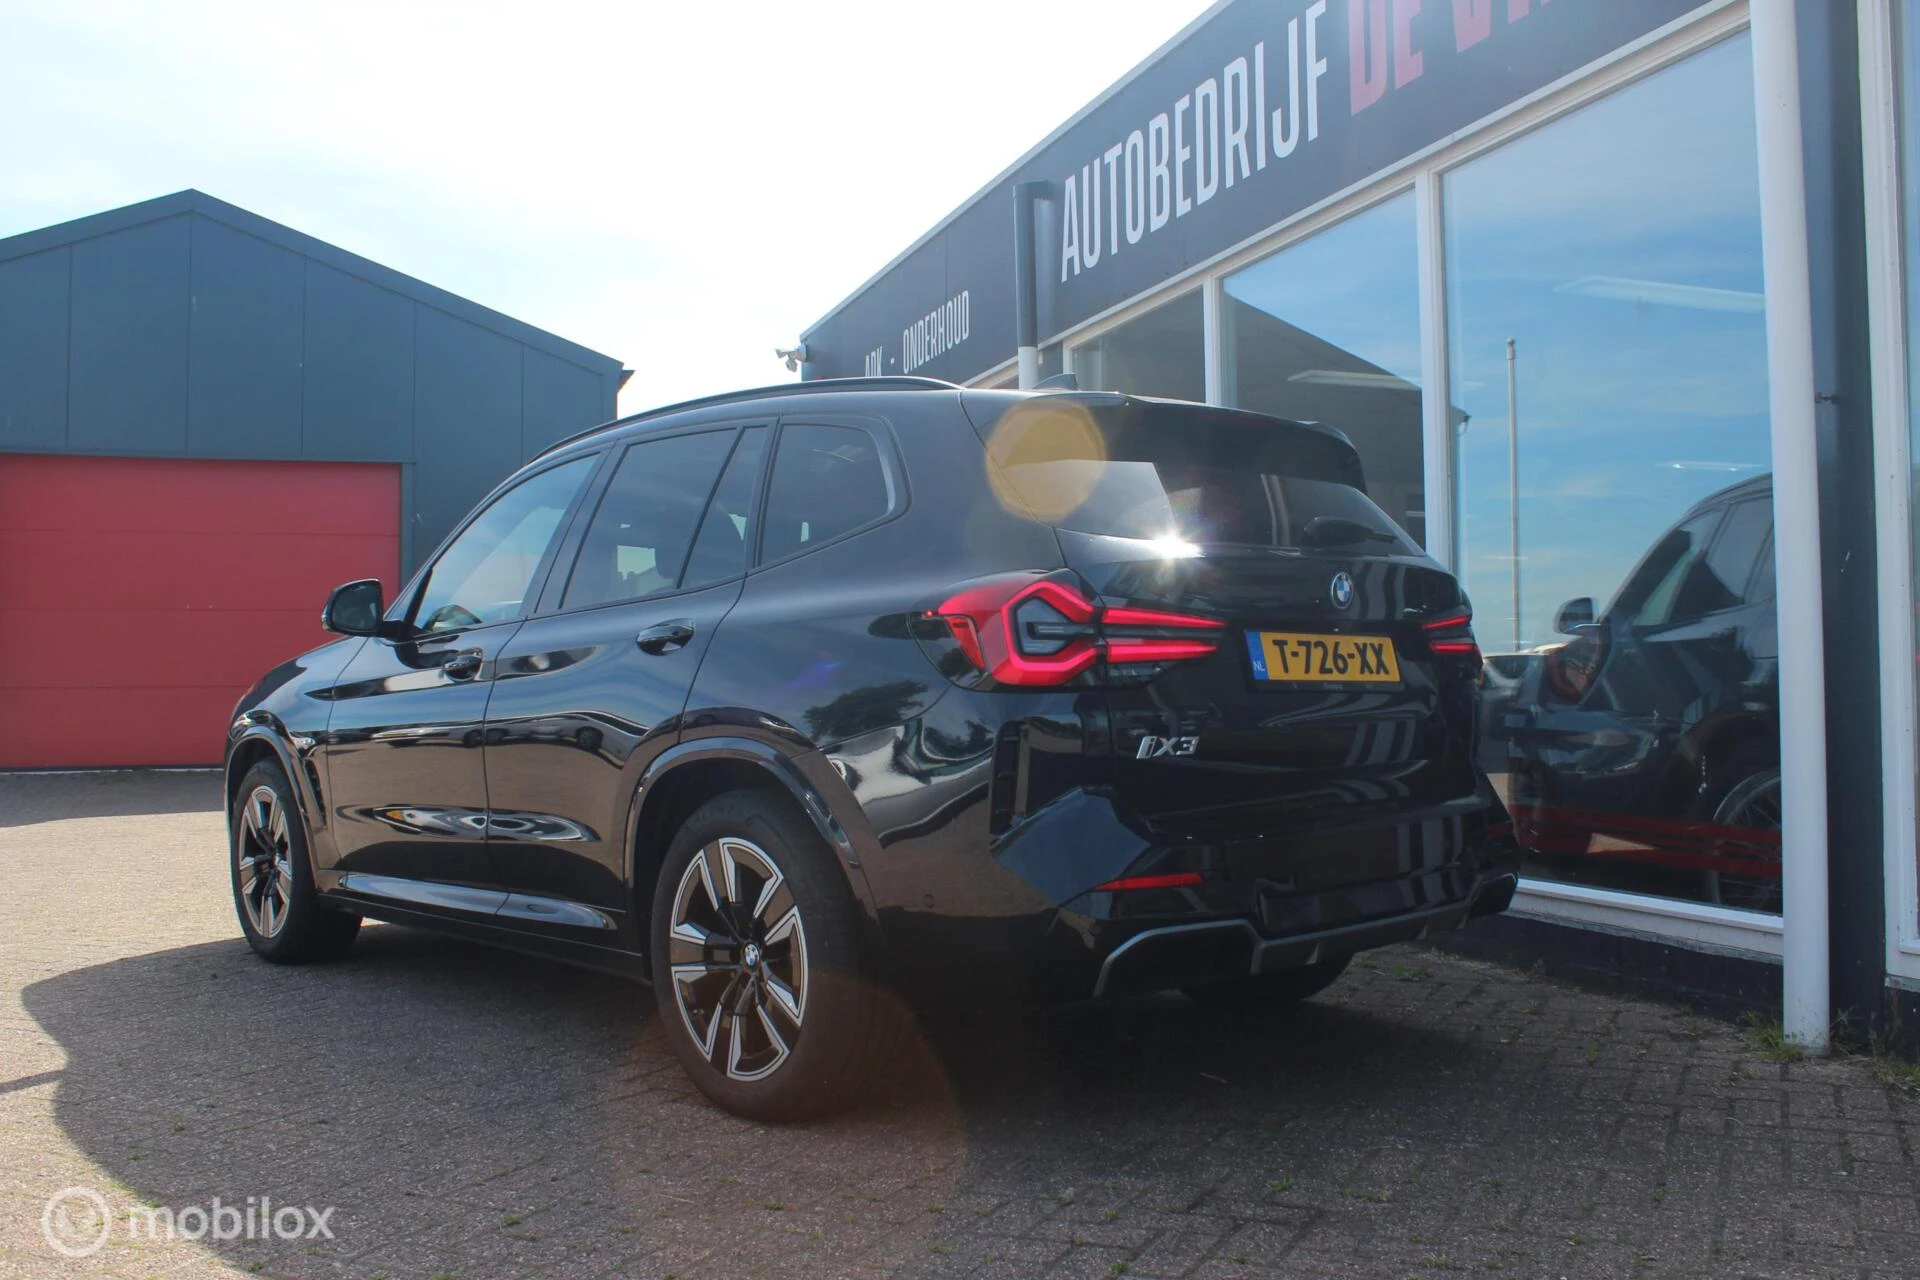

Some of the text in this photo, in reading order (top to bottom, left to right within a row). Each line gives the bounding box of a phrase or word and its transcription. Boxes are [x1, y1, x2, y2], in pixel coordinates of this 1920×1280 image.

[1061, 0, 1424, 283] AUTOBEDRIJF DE
[903, 290, 969, 374] ONDERHOUD
[1253, 660, 1266, 672] NL
[1272, 639, 1390, 675] T-726-XX
